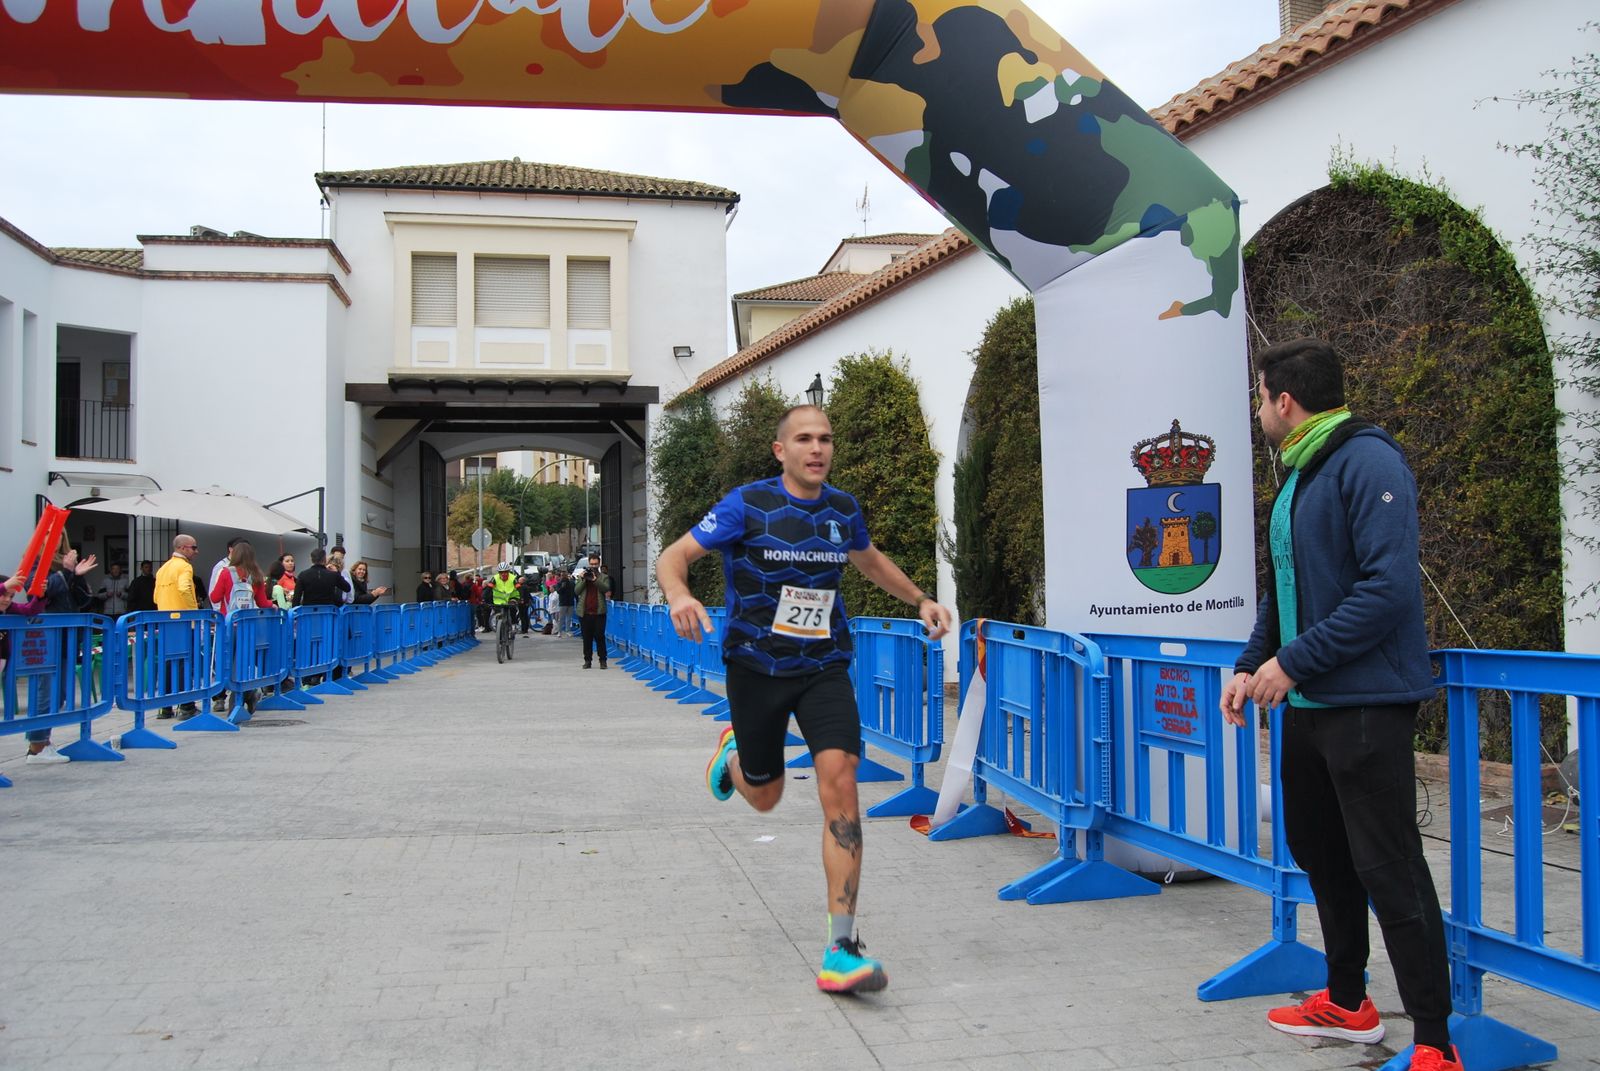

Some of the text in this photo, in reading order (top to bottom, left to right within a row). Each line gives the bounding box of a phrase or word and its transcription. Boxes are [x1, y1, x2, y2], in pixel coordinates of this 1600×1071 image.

[786, 605, 824, 627] 275
[1089, 596, 1245, 618] Ayuntamiento de Montilla
[1155, 683, 1197, 702] AYTO. DE
[1154, 699, 1199, 720] MONTILLA
